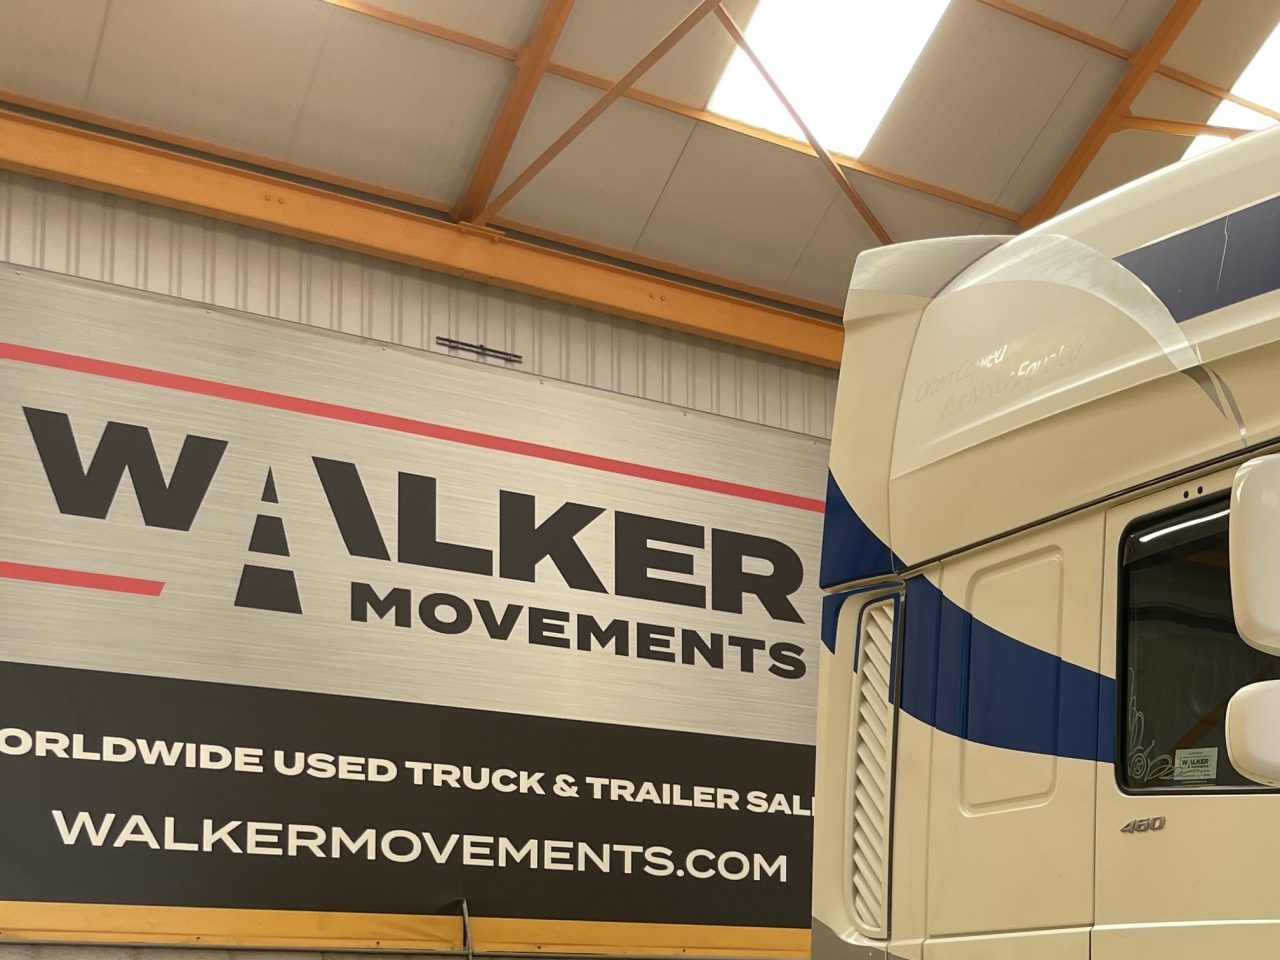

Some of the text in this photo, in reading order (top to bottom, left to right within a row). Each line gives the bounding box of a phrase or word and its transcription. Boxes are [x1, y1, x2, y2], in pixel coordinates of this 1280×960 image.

[22, 405, 806, 625] WALKER
[350, 581, 807, 681] MOVEMENTS
[274, 750, 398, 783] USED
[404, 760, 546, 795] TRUCK
[552, 773, 580, 798] &
[585, 776, 740, 811] TRAILER
[746, 790, 816, 817] SAL
[52, 809, 788, 883] WALKERMOVEMENTS.COM
[1120, 815, 1167, 834] 460
